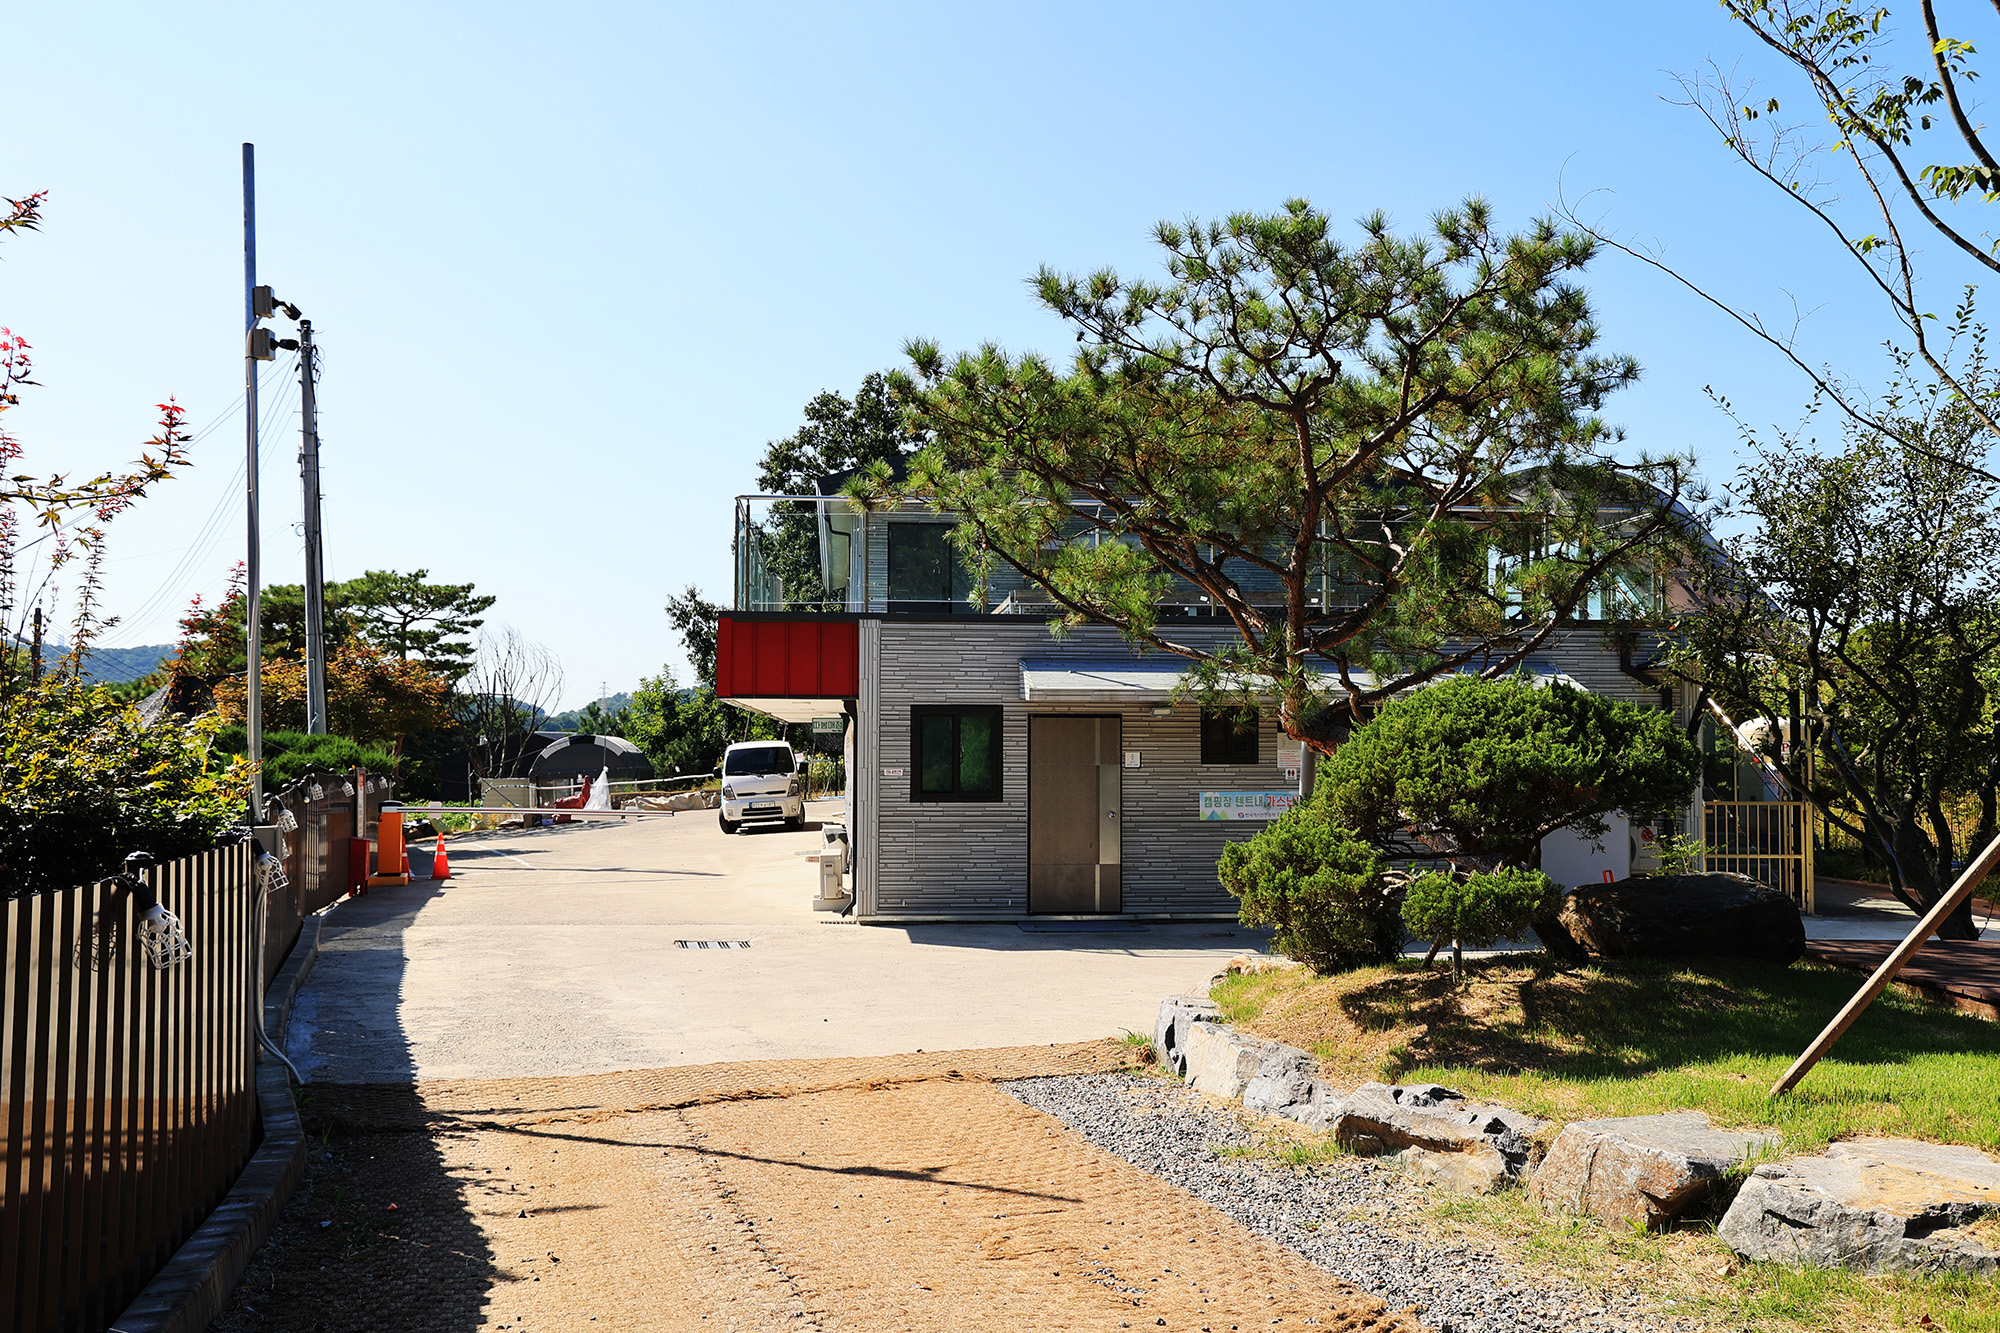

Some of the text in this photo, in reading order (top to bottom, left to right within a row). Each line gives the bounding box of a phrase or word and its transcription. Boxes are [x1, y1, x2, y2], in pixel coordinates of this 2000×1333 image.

[1203, 795, 1300, 808] 캠핑장 텐트내 가스난
